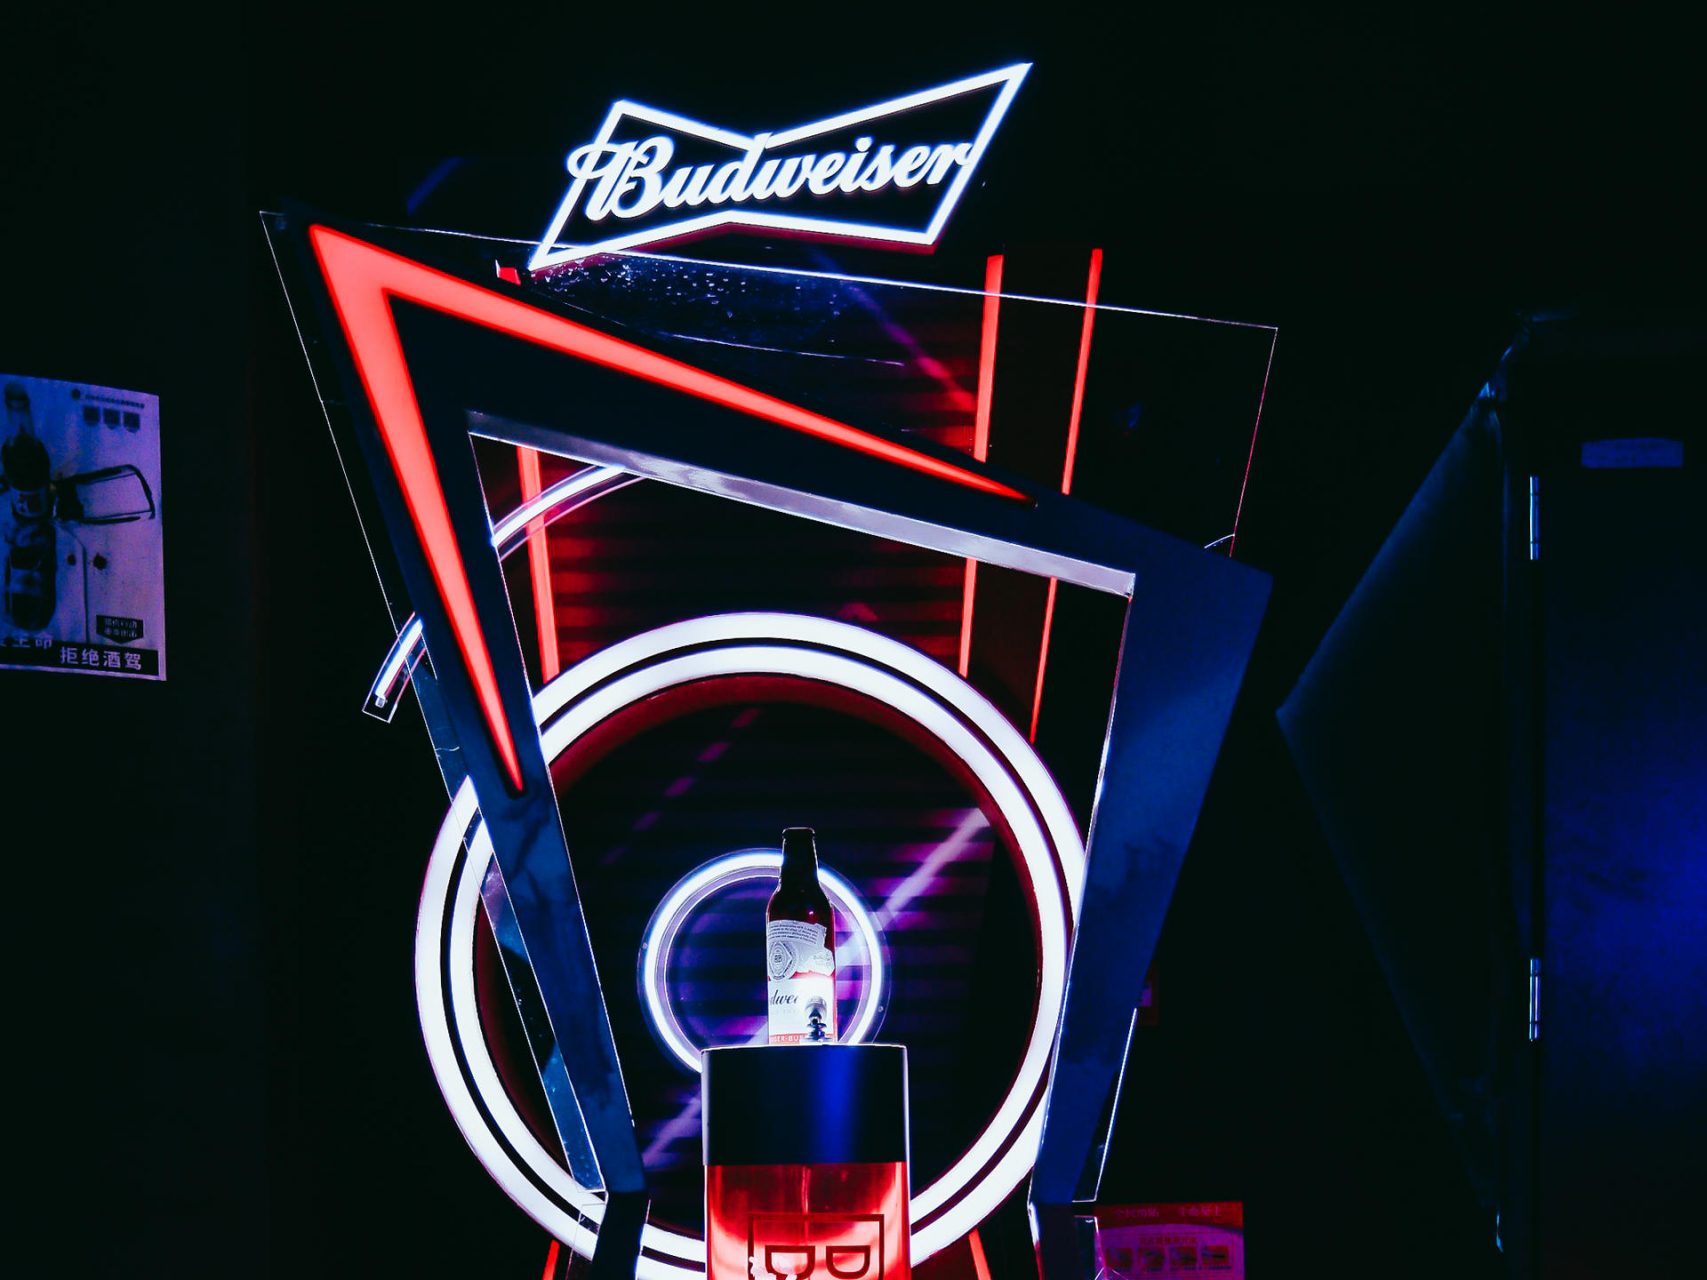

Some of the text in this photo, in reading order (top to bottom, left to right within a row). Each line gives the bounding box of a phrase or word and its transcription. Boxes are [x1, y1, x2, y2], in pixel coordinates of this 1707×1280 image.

[566, 132, 976, 221] Budweiser
[59, 646, 142, 671] 拒绝酒驾
